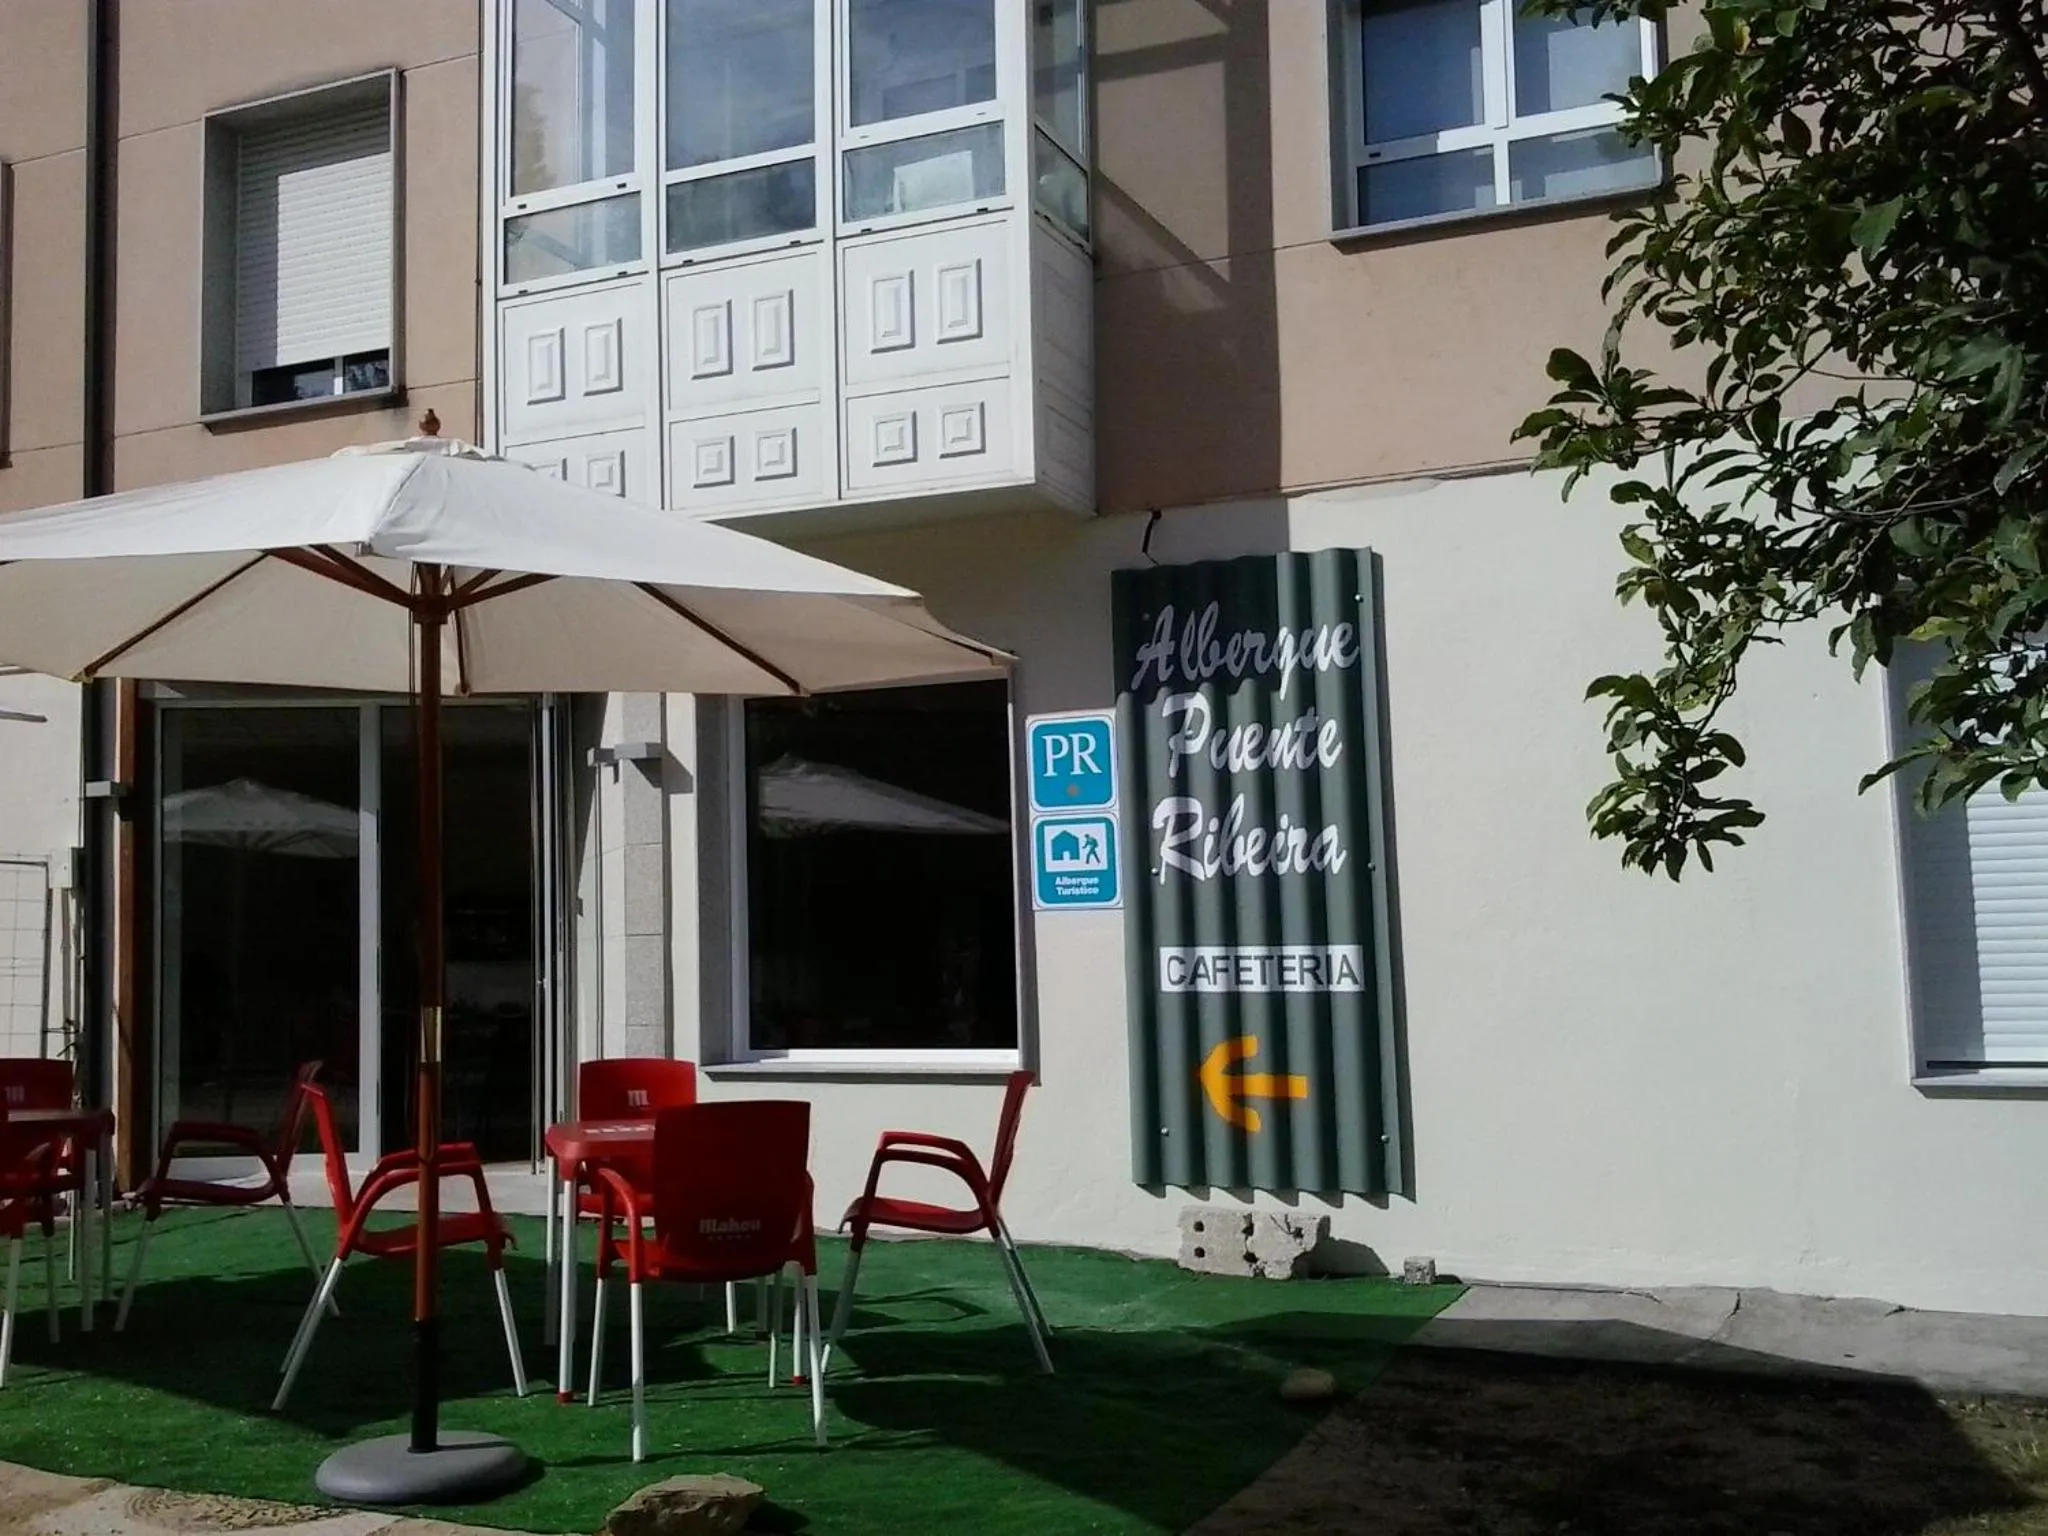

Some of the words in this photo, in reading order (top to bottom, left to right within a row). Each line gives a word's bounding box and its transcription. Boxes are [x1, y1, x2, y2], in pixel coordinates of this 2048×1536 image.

[1131, 601, 1360, 701] Albergue
[1042, 732, 1102, 777] PR
[1162, 692, 1343, 779] Puente
[1152, 793, 1347, 885] Ribeira
[1055, 875, 1100, 886] Albergue
[1166, 953, 1361, 988] CAFETERIA
